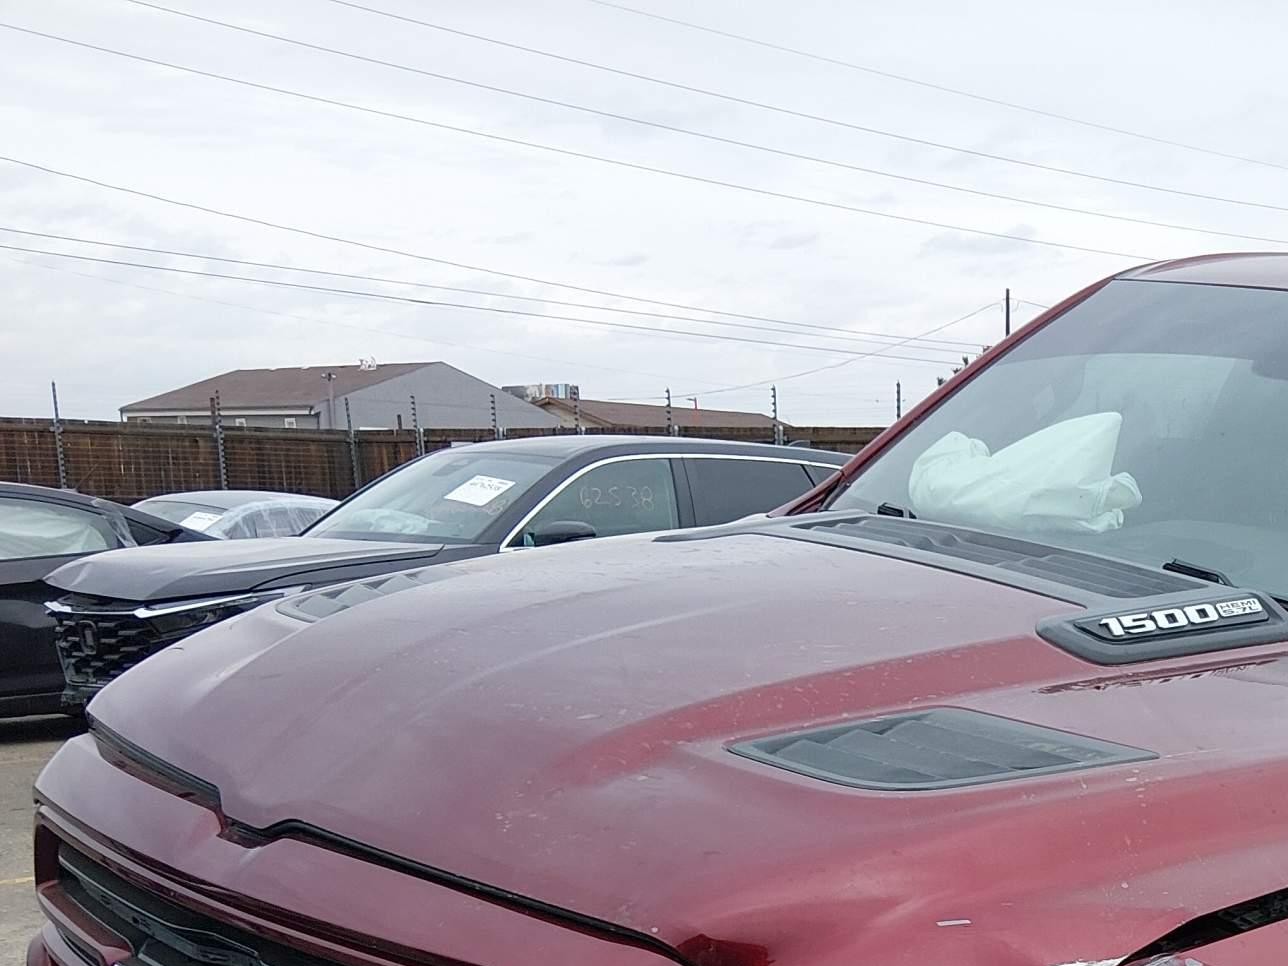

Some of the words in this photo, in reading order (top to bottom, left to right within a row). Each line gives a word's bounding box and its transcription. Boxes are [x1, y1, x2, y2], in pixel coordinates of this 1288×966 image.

[580, 485, 655, 511] 62538
[1219, 599, 1257, 610] HEMI
[1222, 606, 1259, 616] 5.7L
[1098, 603, 1222, 637] 1500
